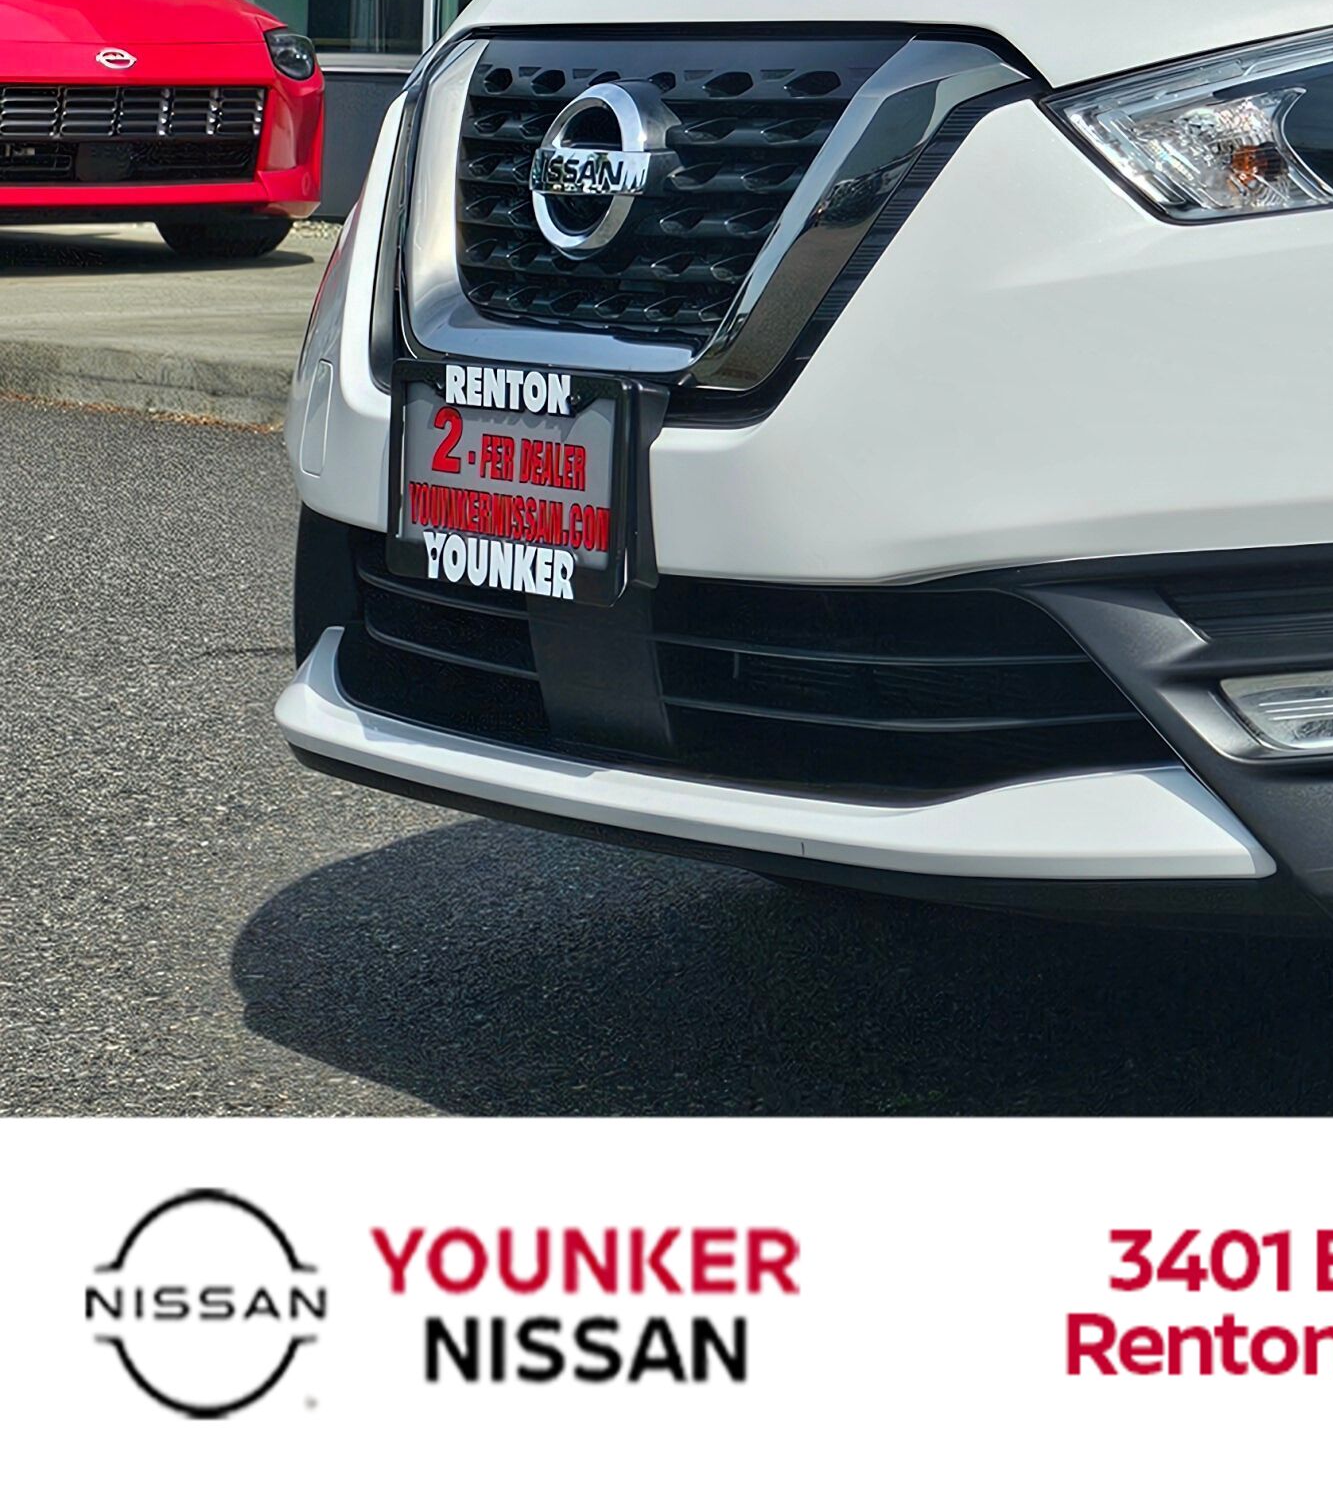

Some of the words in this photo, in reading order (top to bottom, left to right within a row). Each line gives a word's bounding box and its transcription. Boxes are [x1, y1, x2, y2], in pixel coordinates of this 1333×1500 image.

[446, 364, 572, 414] RENTON
[519, 438, 586, 492] DEALER
[422, 531, 575, 600] YOUNKER
